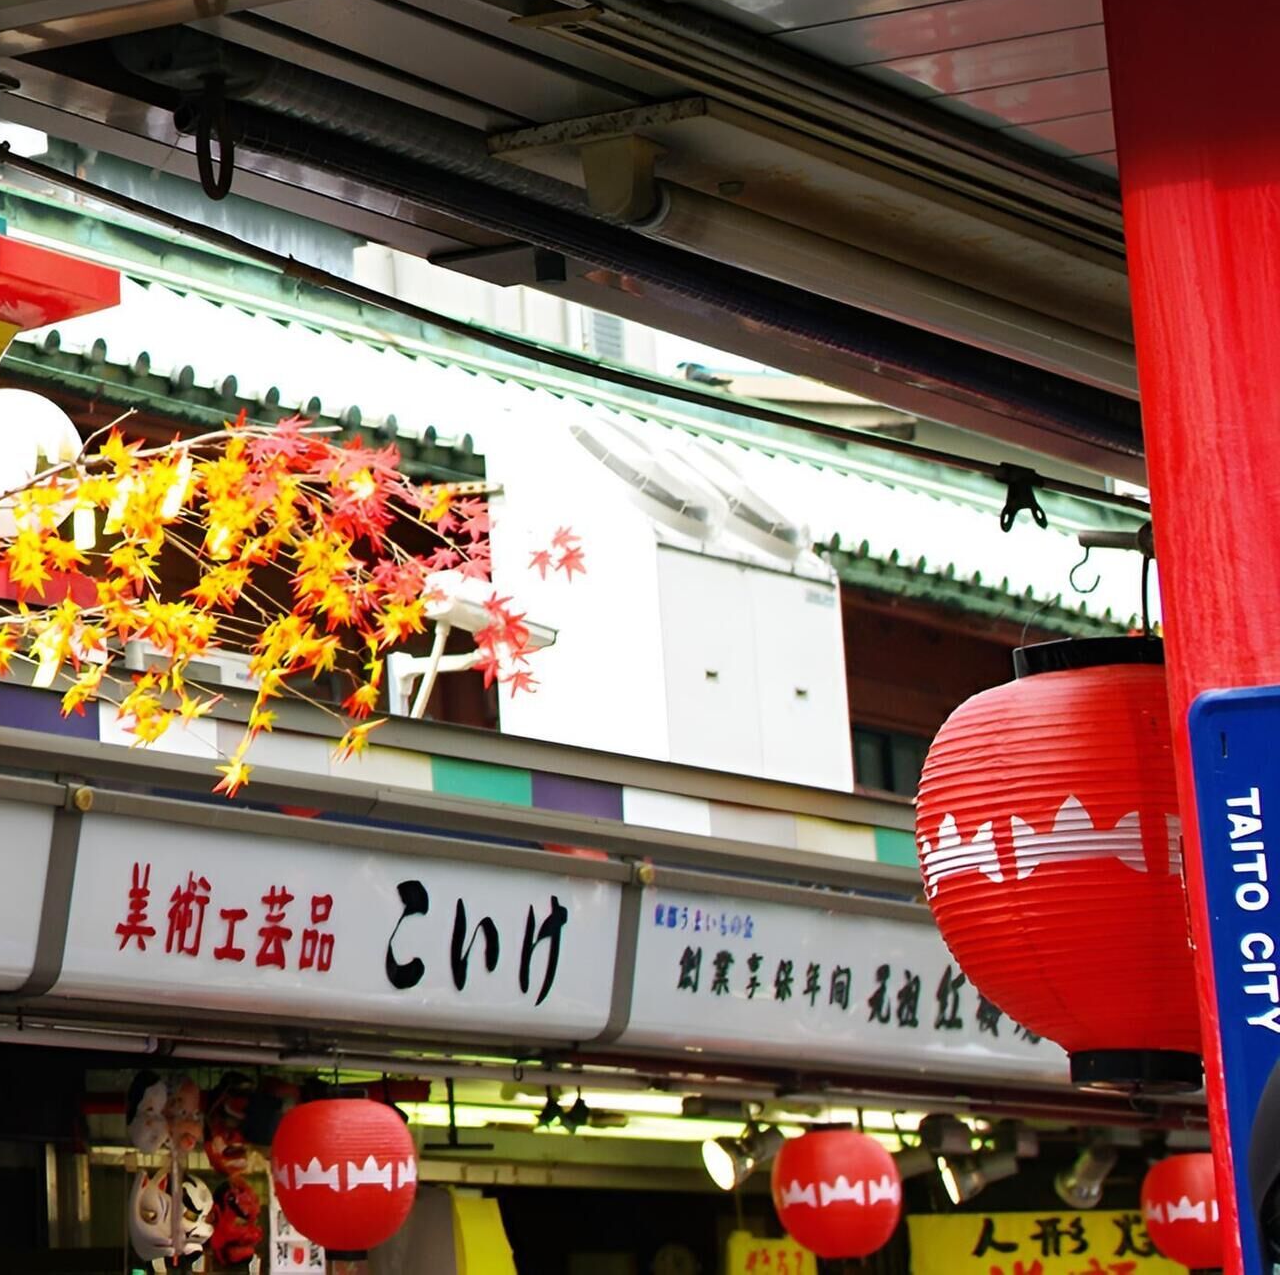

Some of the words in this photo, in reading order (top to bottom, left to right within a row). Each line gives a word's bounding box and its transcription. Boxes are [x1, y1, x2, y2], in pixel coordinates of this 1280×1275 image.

[1225, 785, 1270, 912] TAITO
[114, 861, 336, 973] 美術工芸品
[385, 879, 570, 1007] こいけ
